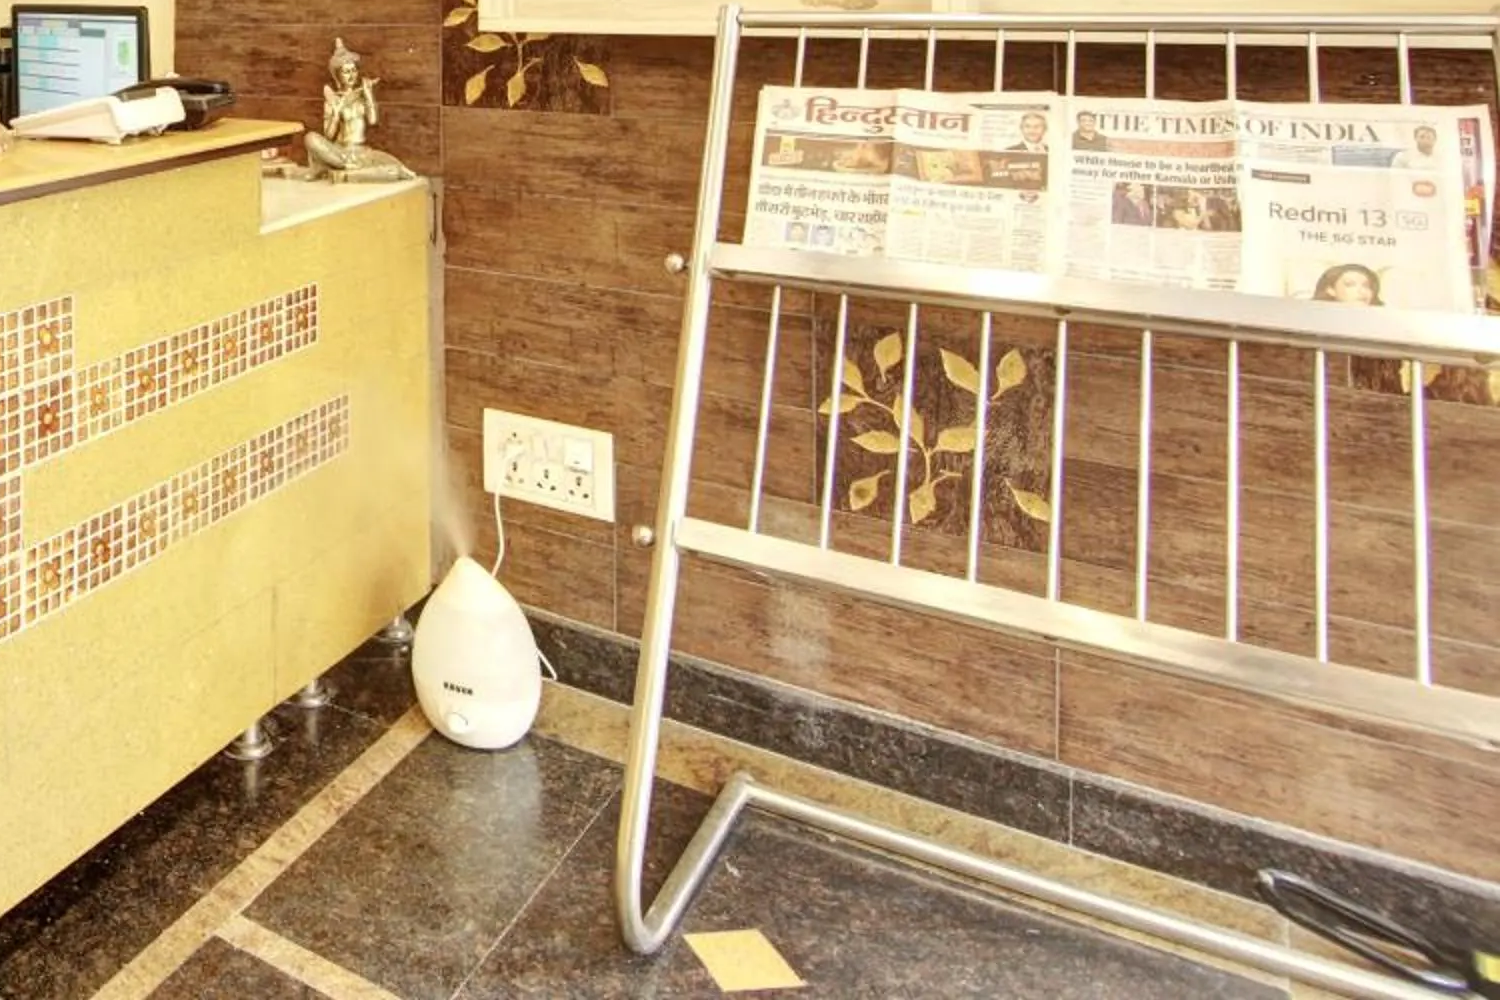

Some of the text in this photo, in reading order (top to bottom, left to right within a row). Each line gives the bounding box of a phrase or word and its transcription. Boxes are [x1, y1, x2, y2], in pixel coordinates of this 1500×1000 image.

[1098, 113, 1381, 142] THE TIMES OF INDIA
[1268, 201, 1348, 226] Redmi
[1360, 209, 1388, 228] 13
[1299, 230, 1397, 247] THE 5G STAR
